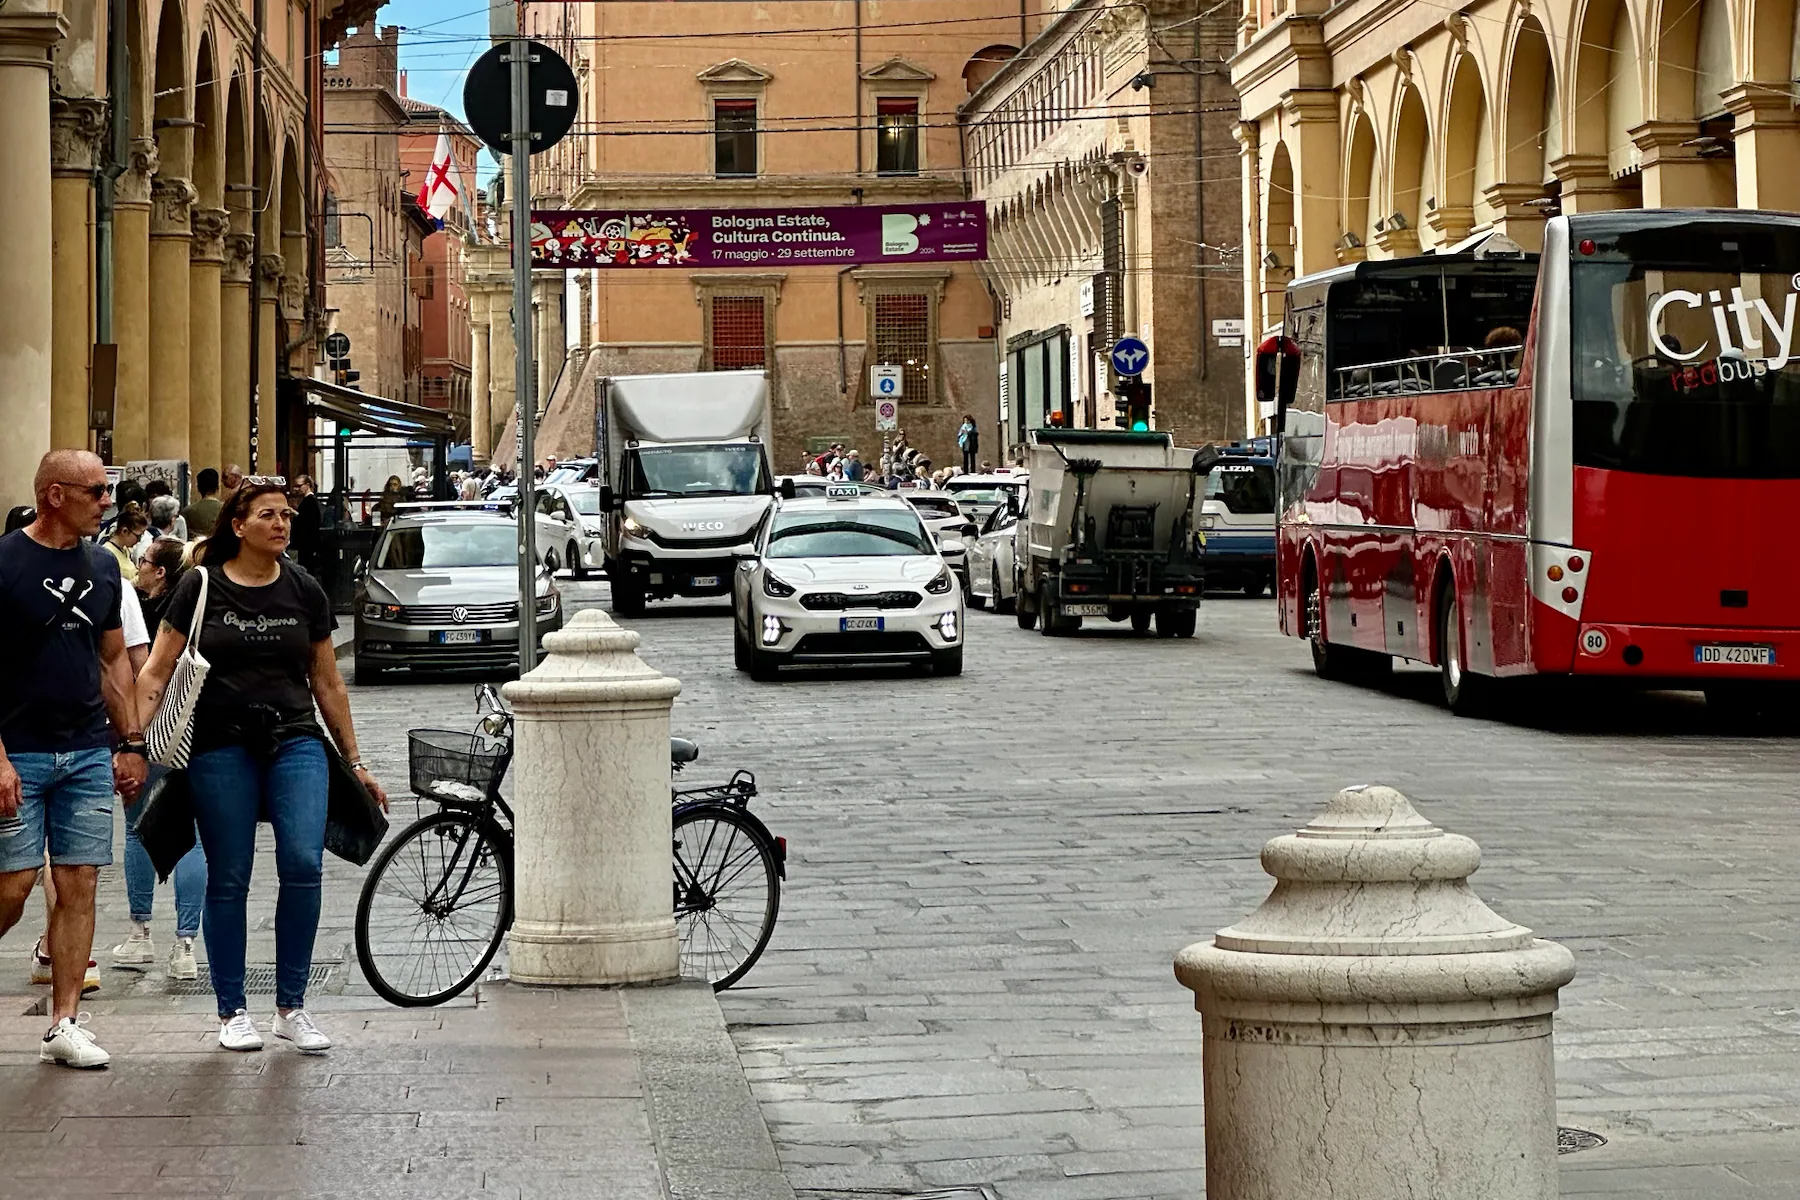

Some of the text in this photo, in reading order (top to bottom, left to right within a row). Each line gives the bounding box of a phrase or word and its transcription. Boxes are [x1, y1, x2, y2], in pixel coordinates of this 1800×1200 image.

[711, 213, 831, 230] Bologna Estate,
[712, 228, 846, 244] Cultura Continua.
[711, 246, 856, 261] 17 maggio 29 settembre
[919, 247, 936, 255] 2024
[1649, 287, 1797, 371] City
[1211, 465, 1255, 473] OLIZIA
[831, 488, 857, 496] TAXI
[682, 521, 725, 532] IVECO
[223, 610, 257, 632] Pepe
[1587, 635, 1603, 648] 80
[1704, 648, 1768, 662] DD 420WF
